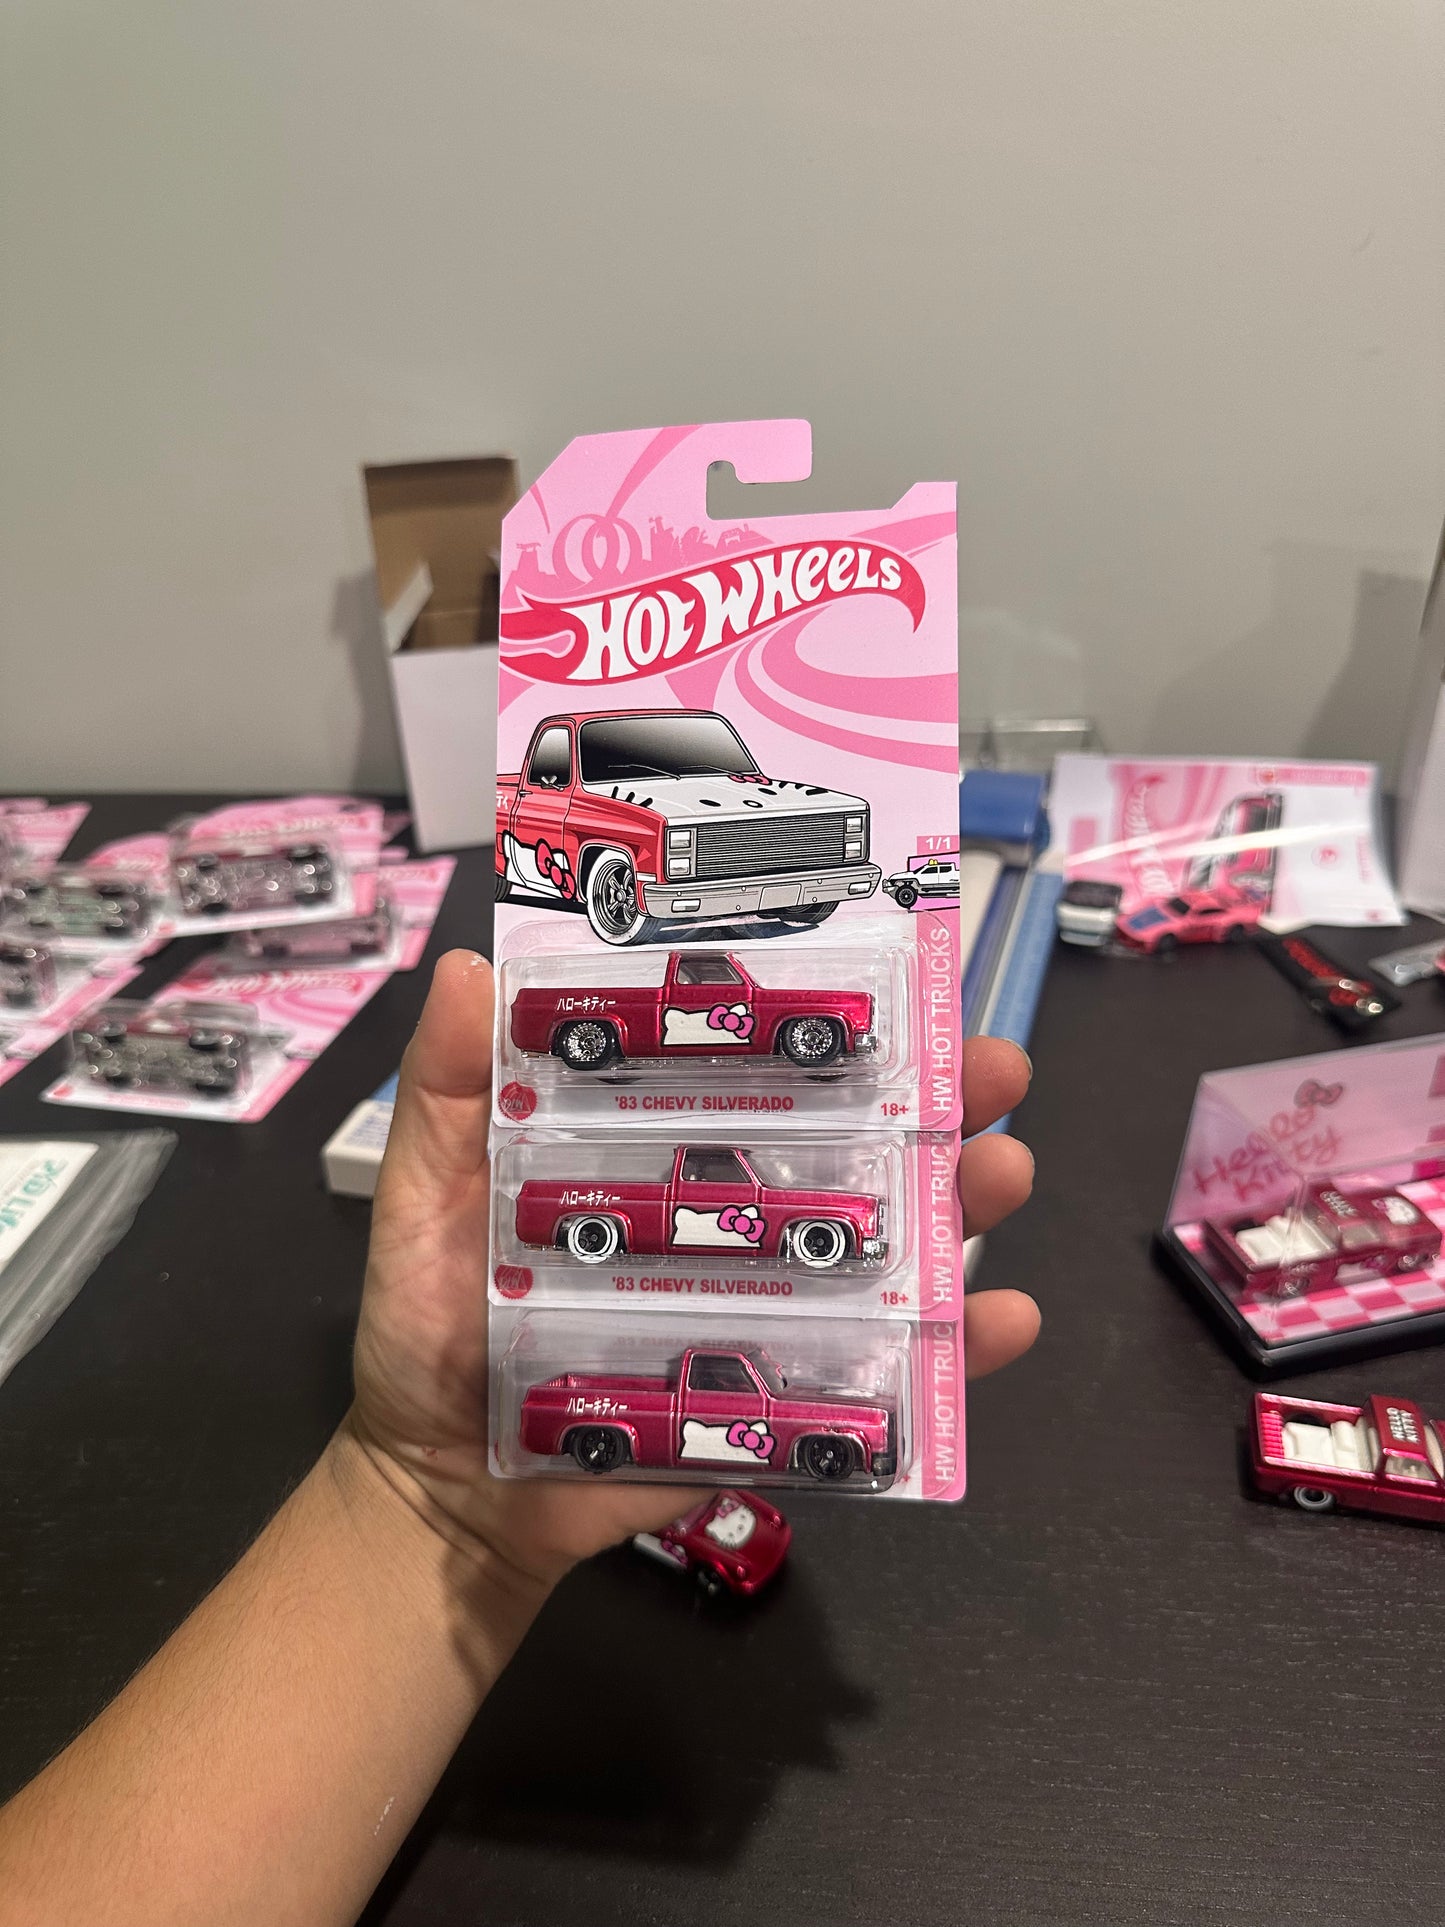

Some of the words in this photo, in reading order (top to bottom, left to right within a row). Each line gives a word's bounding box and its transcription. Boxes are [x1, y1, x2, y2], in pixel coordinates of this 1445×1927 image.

[559, 590, 696, 681] HOT
[925, 836, 952, 850] 1/1
[930, 927, 952, 1018] TRUCKS
[556, 996, 616, 1011] ハローキティー
[931, 1020, 952, 1070] HOT
[614, 1096, 638, 1110] '83
[642, 1096, 698, 1110] CHEVY
[701, 1096, 794, 1111] SILVERADO
[932, 1074, 952, 1112] HW
[880, 1103, 909, 1117] 18+
[560, 1190, 621, 1207] ハローキティー
[932, 1210, 953, 1262] HOT
[612, 1277, 635, 1291] '83
[639, 1277, 695, 1293] CHEVY
[699, 1279, 793, 1296] SILVERADO
[933, 1264, 953, 1302] HW
[880, 1291, 909, 1306] 18+
[566, 1397, 628, 1416] ハローキティー
[934, 1390, 955, 1438] HOT
[935, 1443, 955, 1482] HW
